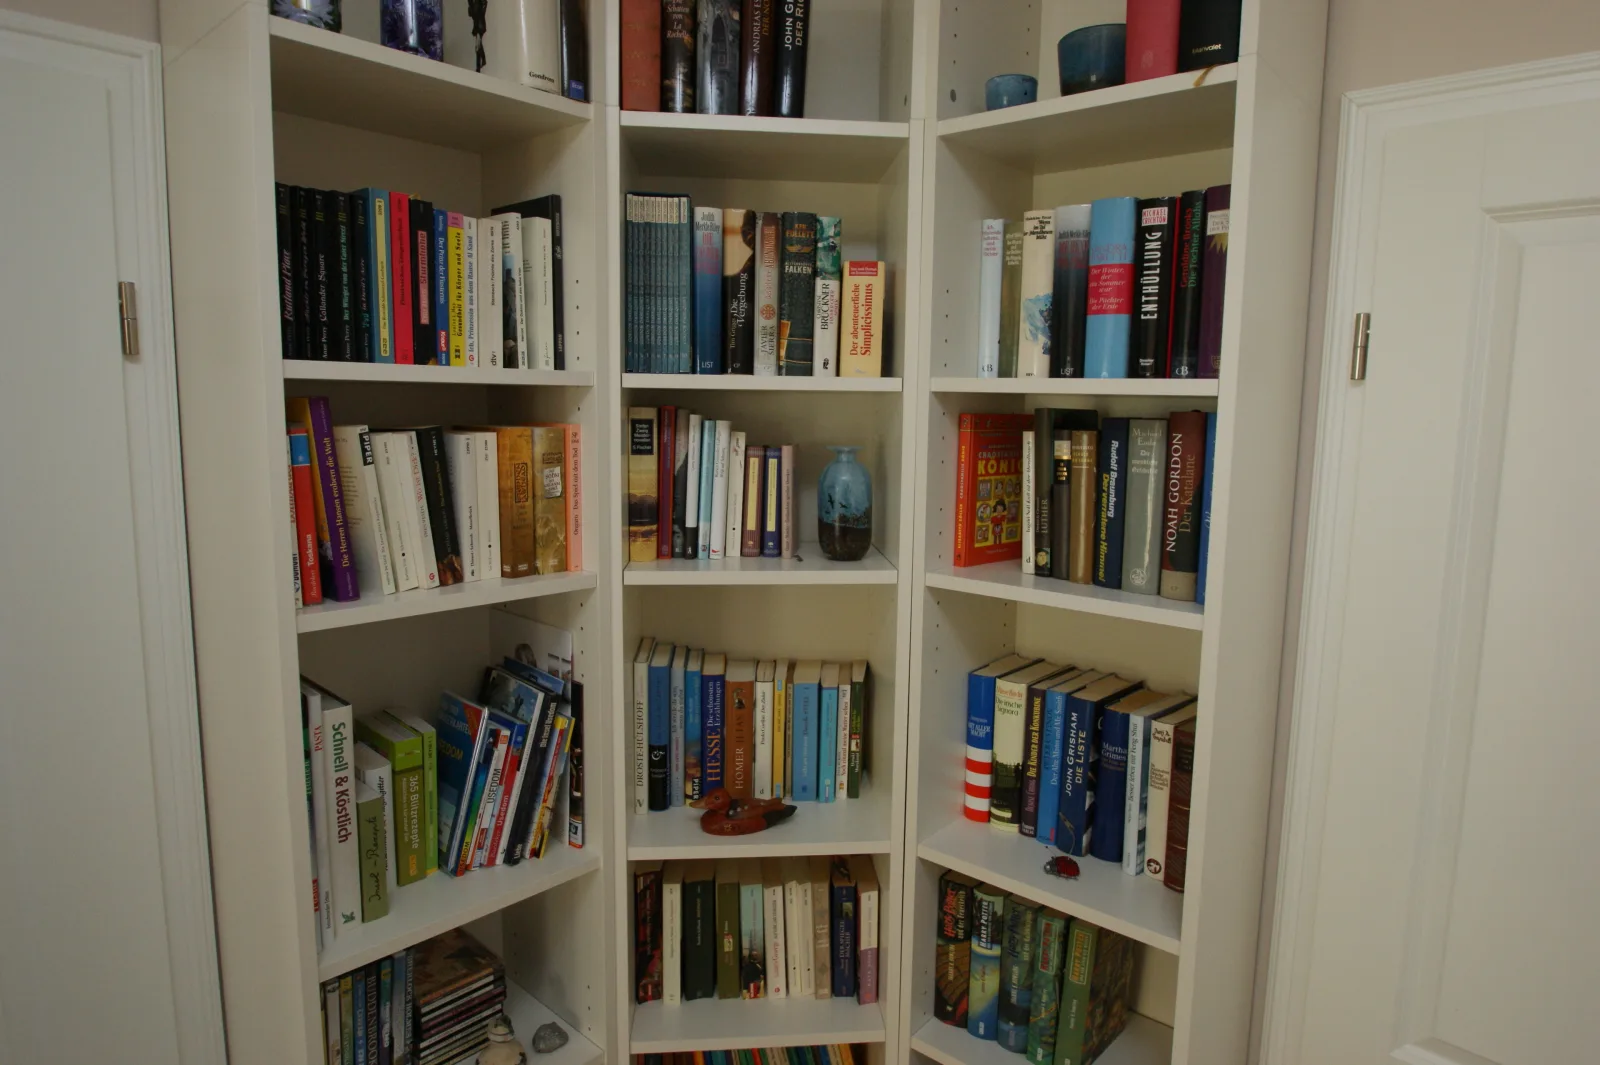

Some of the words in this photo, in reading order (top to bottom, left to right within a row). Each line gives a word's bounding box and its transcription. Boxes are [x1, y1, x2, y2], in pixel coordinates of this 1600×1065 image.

[673, 21, 682, 30] La
[752, 10, 762, 54] ANDREAS
[762, 18, 770, 36] DER
[784, 18, 793, 50] JOHN
[795, 21, 803, 46] DER
[528, 70, 555, 84] Gondrom
[701, 212, 715, 221] Judith
[1141, 216, 1167, 225] CRICHTON
[1142, 208, 1167, 217] MICHAEL
[1182, 207, 1193, 240] Brooks
[1191, 202, 1202, 231] Allahs
[438, 237, 446, 249] Der
[317, 253, 327, 281] Square
[438, 249, 447, 265] Prinz
[1179, 242, 1191, 287] Geraldine
[438, 265, 447, 276] der
[455, 268, 463, 290] Körper
[785, 265, 812, 274] FALKEN
[1141, 231, 1162, 319] ENTHÜLLUNG
[1187, 271, 1198, 287] Die
[282, 278, 294, 321] Rutland
[341, 286, 350, 310] Würger
[438, 276, 447, 304] Finsternis
[735, 272, 748, 327] Vergebung
[1098, 296, 1125, 304] Pächter
[318, 284, 328, 322] Callander
[730, 299, 739, 314] Die
[849, 284, 860, 340] abenteuerliche
[467, 308, 475, 339] Prinzessin
[729, 317, 738, 337] Griggs
[860, 283, 874, 356] Simplicissimus
[343, 325, 351, 341] Perry
[729, 337, 737, 349] Tim
[761, 325, 769, 356] JAVIER
[768, 325, 776, 356] SIERRA
[850, 341, 859, 356] Der
[701, 361, 714, 369] LIST
[1060, 367, 1074, 376] LIST
[1132, 427, 1162, 437] Michael
[323, 437, 334, 454] Welt
[362, 434, 374, 463] PIPER
[1109, 440, 1119, 470] Rudolf
[326, 456, 335, 467] die
[1168, 432, 1182, 503] GORDON
[329, 469, 340, 497] erobern
[1101, 473, 1110, 491] Der
[1179, 454, 1196, 506] Katalane
[1107, 470, 1118, 518] Braunburg
[333, 498, 344, 526] Hansen
[1100, 491, 1109, 540] verratene
[1179, 508, 1192, 532] Der
[338, 527, 349, 553] Herren
[1165, 507, 1178, 551] NOAH
[304, 534, 315, 566] Toskana
[340, 554, 350, 567] Die
[1098, 541, 1108, 582] Himmel
[706, 681, 714, 713] schönsten
[713, 681, 722, 726] Erzählungen
[1054, 695, 1062, 714] Smith
[543, 702, 557, 724] Usedom
[1029, 696, 1041, 731] KONKUBINE
[313, 724, 323, 752] PASTA
[541, 725, 552, 738] Insel
[1029, 732, 1039, 743] DER
[1053, 727, 1061, 740] und
[1066, 711, 1078, 766] GRISHAM
[1130, 722, 1138, 738] Shui
[332, 722, 350, 773] Schnell
[539, 738, 548, 748] Die
[1052, 740, 1060, 758] Mann
[1076, 730, 1086, 763] LISTE
[1102, 741, 1128, 754] Martha
[1129, 738, 1138, 754] Feng
[706, 728, 722, 782] HESSE
[1027, 744, 1038, 766] KINDER
[1051, 759, 1059, 771] Alte
[1102, 750, 1127, 761] Grimes
[734, 747, 744, 788] HOMER
[1026, 766, 1036, 777] DIE
[1050, 772, 1058, 785] Der
[1075, 766, 1084, 784] DIE
[1128, 766, 1136, 782] leben
[335, 775, 349, 788] &
[409, 775, 420, 792] 365
[486, 768, 501, 804] USEDOM
[692, 778, 700, 800] PIPER
[1065, 768, 1074, 797] JOHN
[1127, 782, 1135, 802] Besser
[335, 788, 353, 844] Köstlich
[409, 794, 421, 849] Blitzrezepte
[496, 795, 510, 826] Usedom
[458, 841, 472, 872] USEDOM
[513, 843, 523, 860] Liebe
[944, 887, 957, 913] Potter
[981, 901, 990, 924] POTTER
[943, 914, 956, 937] Harry
[980, 925, 989, 948] HARRY
